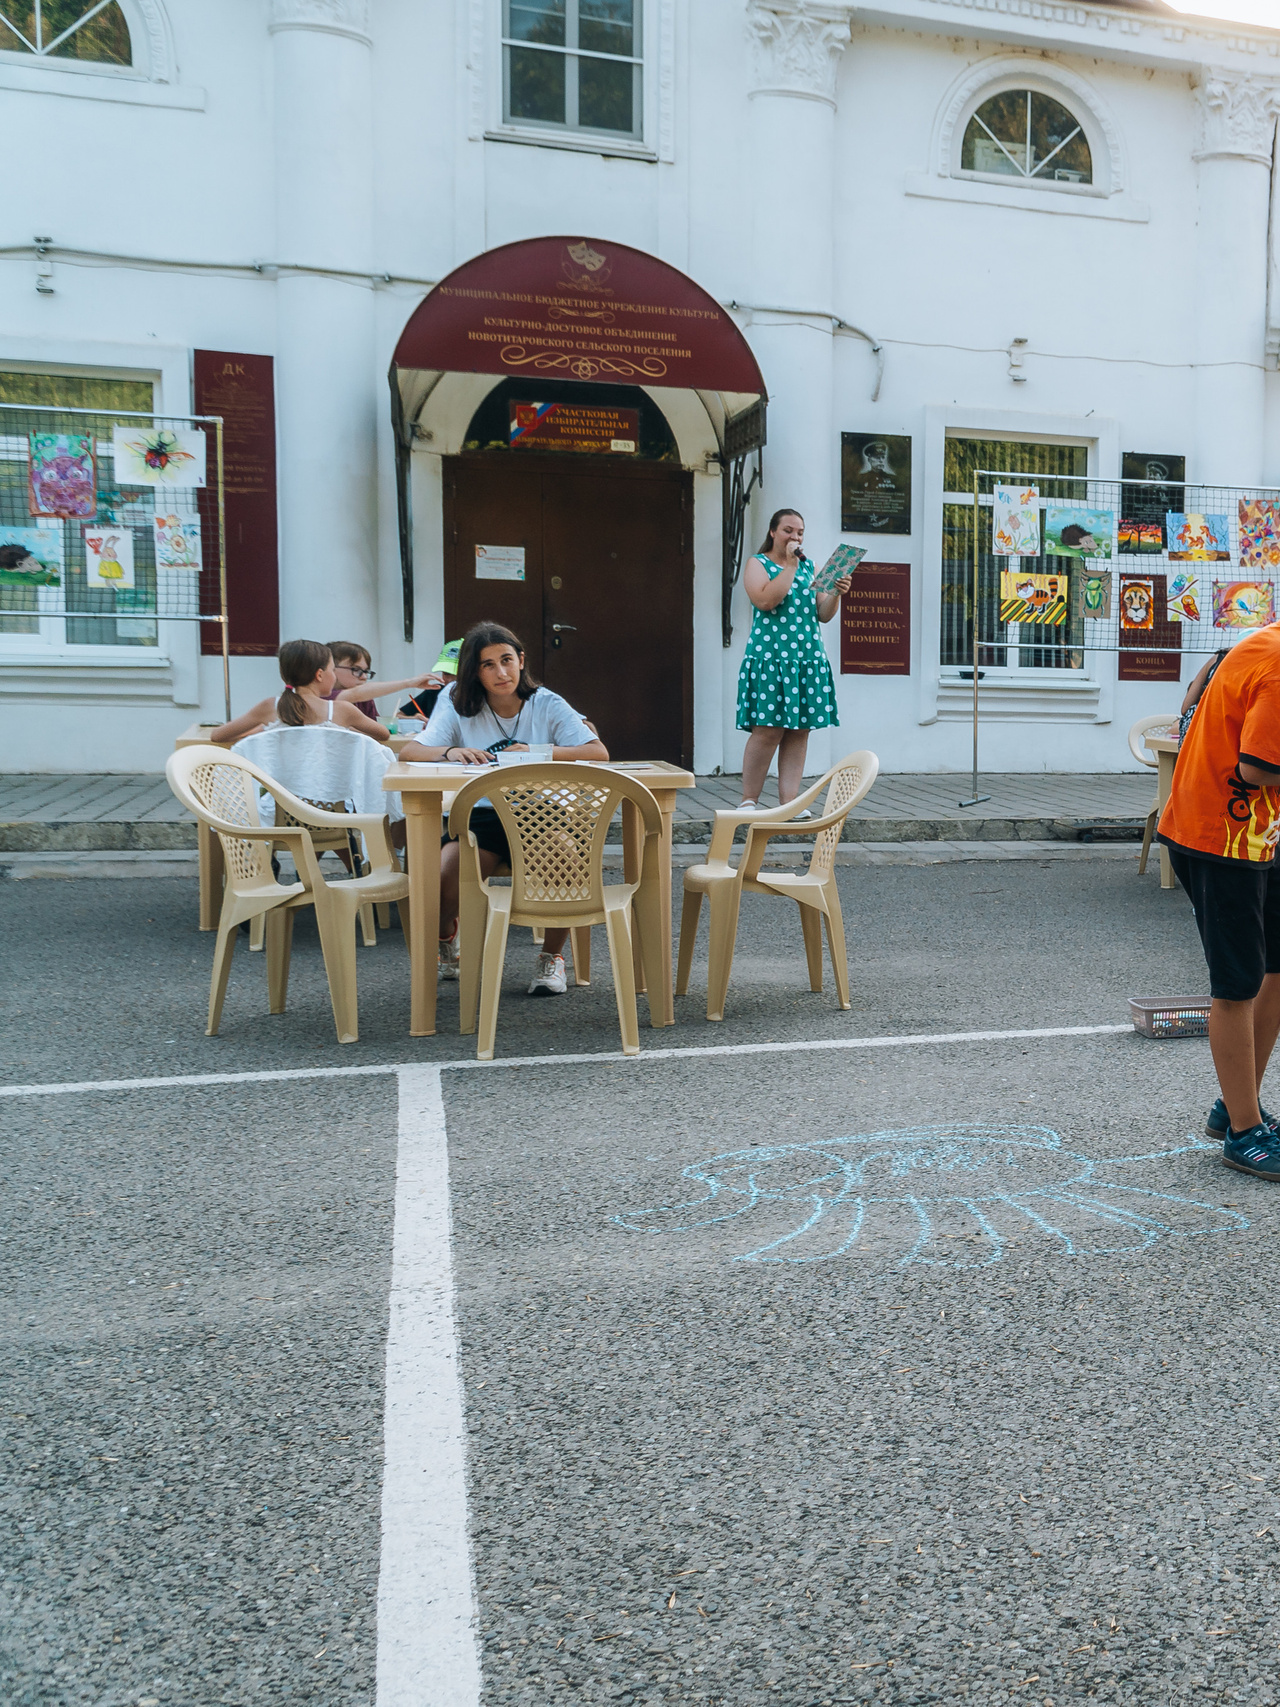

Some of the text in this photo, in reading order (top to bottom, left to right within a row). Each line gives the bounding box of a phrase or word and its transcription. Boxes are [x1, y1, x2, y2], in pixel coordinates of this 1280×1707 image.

[439, 286, 719, 320] МУНИЦИПАЛЬНОЕ БЮДЖЕТНОЕ УЧРЕЖДЕНИЕ КУЛЬТУРЫ
[484, 316, 678, 342] КУЛЬТУРНО-ДОСУГОВОЕ ОБЪЕДИНЕНИЕ
[468, 331, 692, 358] НОВОТИТАРОВСКОГО СЕЛЬСКОГО ПОСЕЛЕНИЯ
[222, 362, 245, 376] ДК
[556, 408, 619, 420] УЧАСТКОВАЯ
[545, 416, 630, 430] ИЗБИРАТЕЛЬНАЯ
[560, 427, 616, 437] КОМИССИЯ
[850, 591, 899, 599] ПОМНИТЕ!
[846, 605, 874, 613] ЧЕРЕЗ
[844, 620, 873, 628] ЧЕРЕЗ
[850, 635, 900, 644] ПОМНИТЕ!
